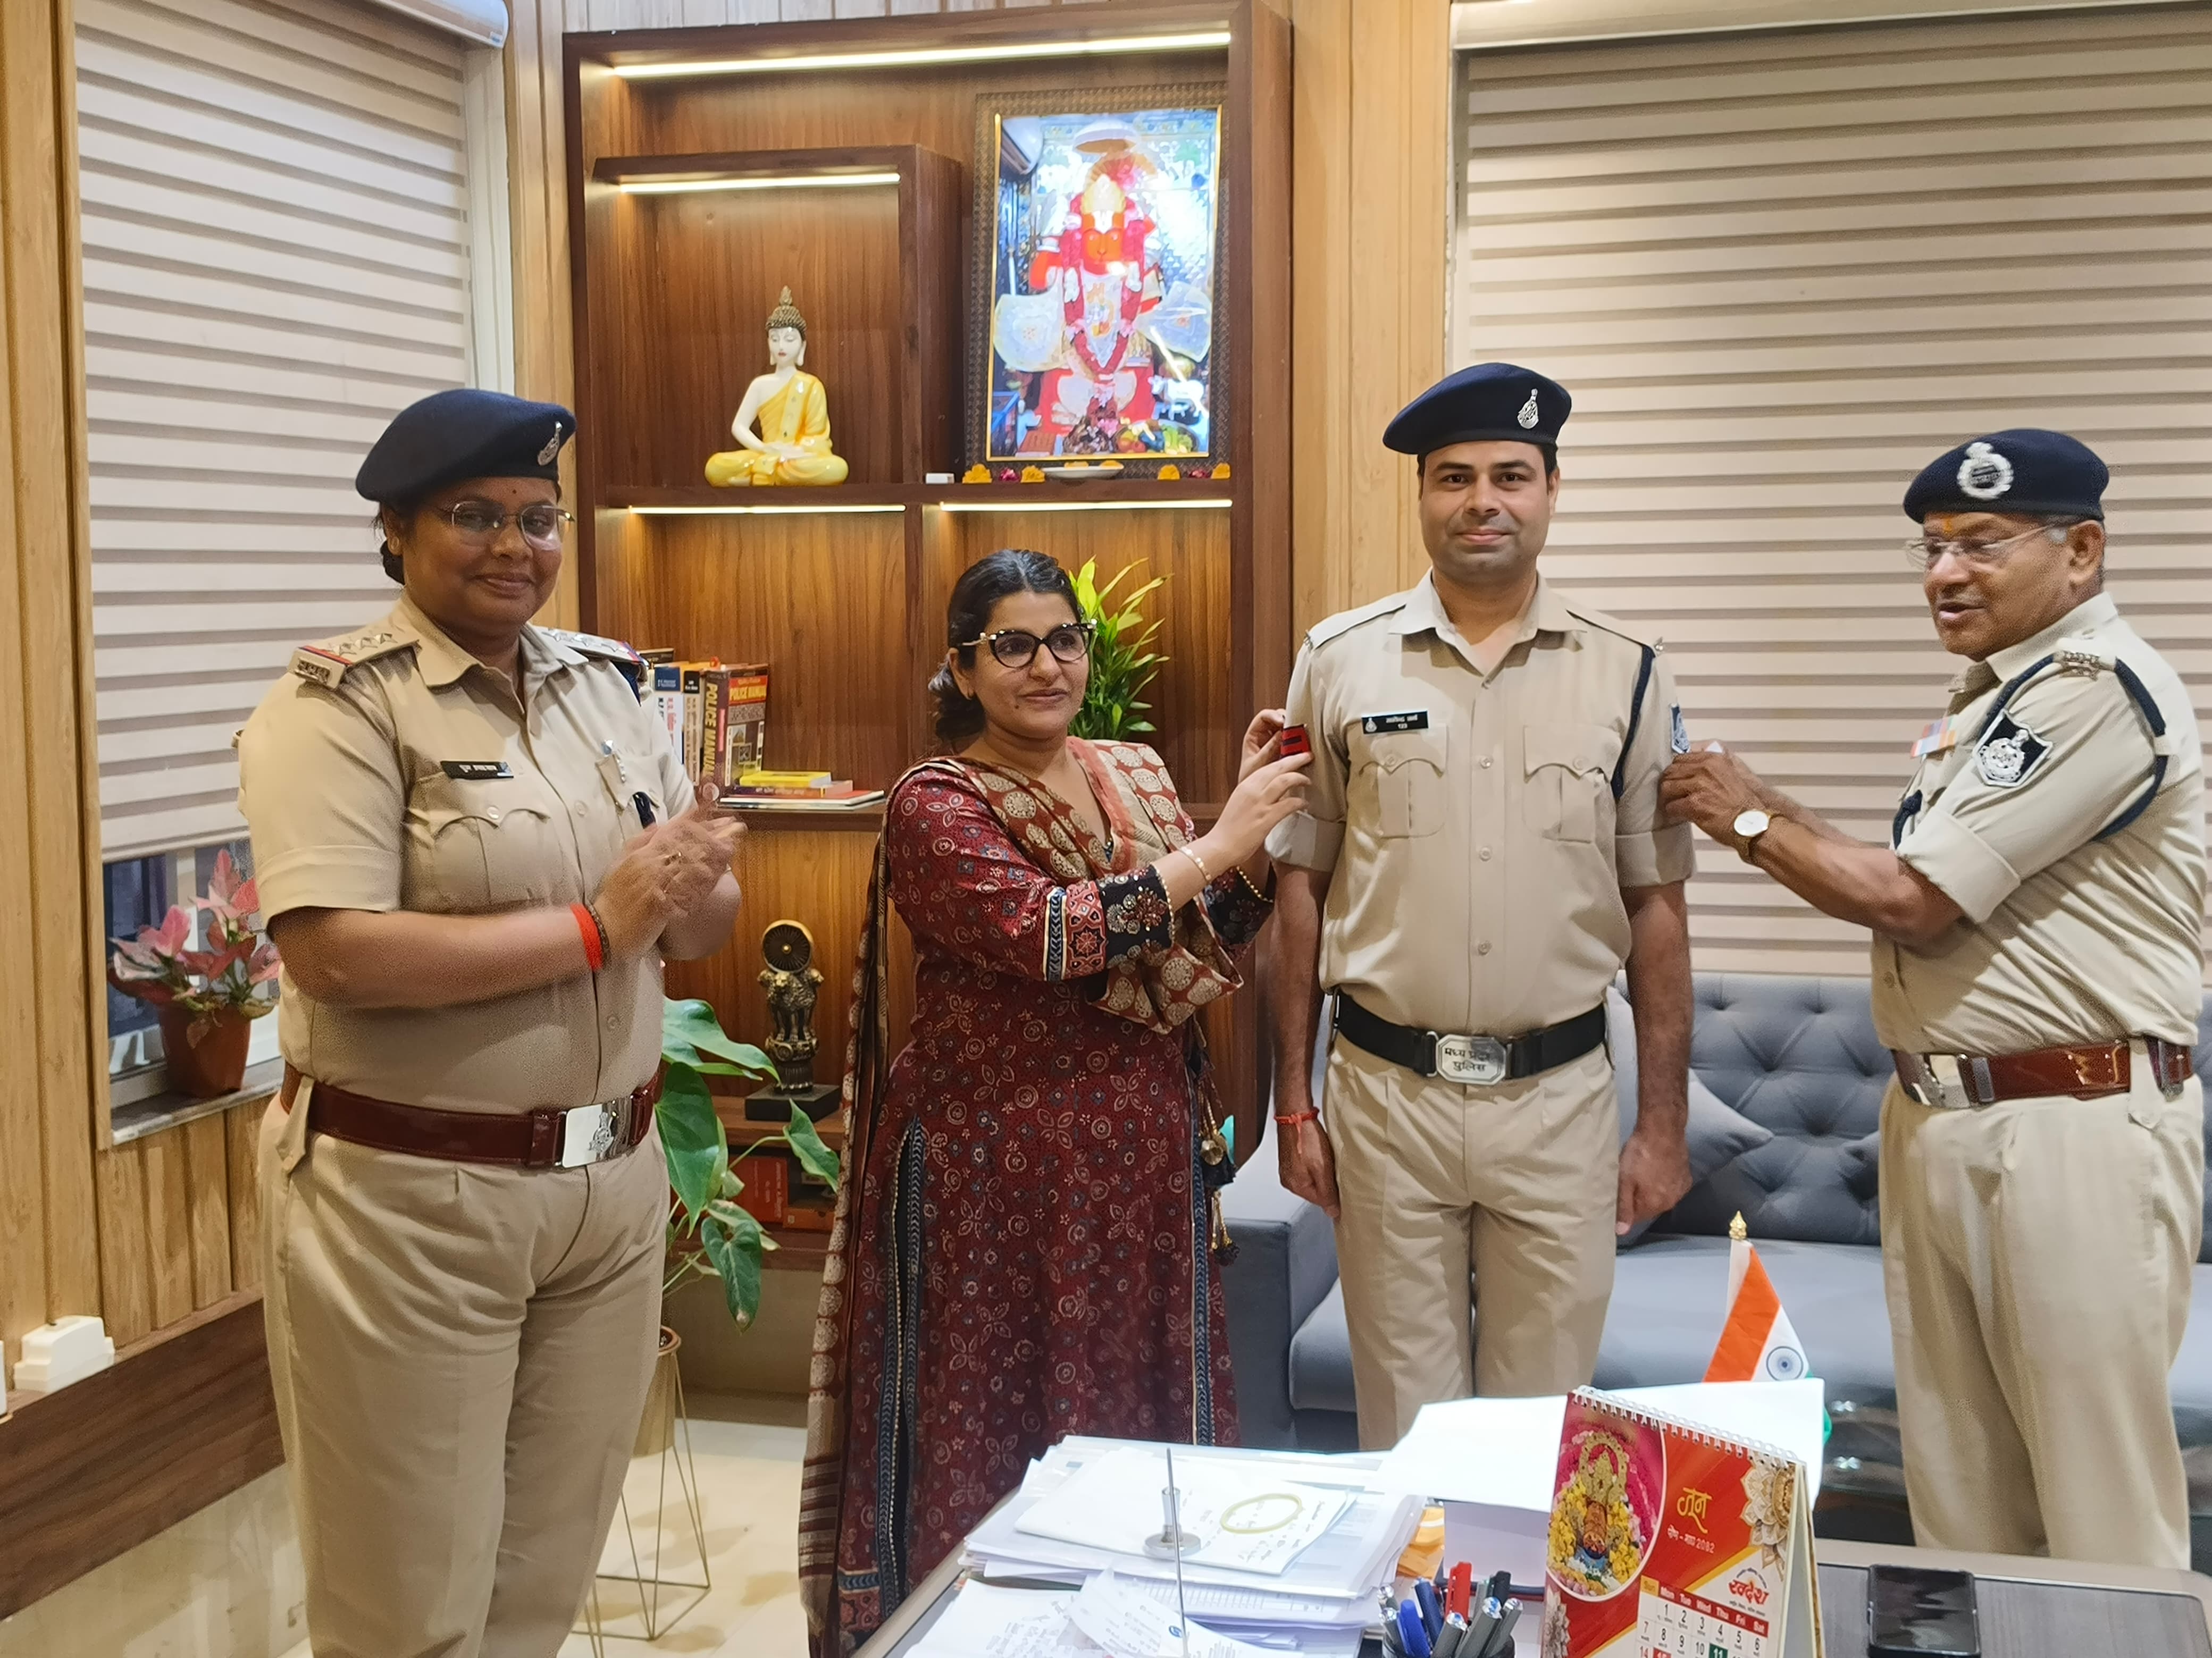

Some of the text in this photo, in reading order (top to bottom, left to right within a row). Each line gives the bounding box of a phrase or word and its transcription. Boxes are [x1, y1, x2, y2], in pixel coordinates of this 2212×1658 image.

[703, 684, 718, 777] POLICE MANUAL
[1452, 1061, 1486, 1072] पुलिस
[1677, 1487, 1713, 1535] जून
[1644, 1580, 1656, 1594] Sun
[1661, 1586, 1675, 1599] Mon
[1680, 1593, 1691, 1605] Tue
[1696, 1600, 1712, 1613] Wed
[1716, 1606, 1729, 1620] Thu
[1736, 1614, 1746, 1626] Fri
[1754, 1621, 1765, 1634] Sat
[1728, 1579, 1769, 1605] स्वदेश
[1644, 1621, 1649, 1633] 7
[1661, 1628, 1666, 1641] 8
[1679, 1635, 1685, 1647] 9
[1696, 1642, 1705, 1655] 10
[1713, 1648, 1723, 1658] 11
[1664, 1604, 1668, 1616] 1
[1681, 1610, 1687, 1622] 2
[1700, 1617, 1705, 1629] 3
[1717, 1624, 1723, 1636] 4
[1736, 1630, 1741, 1643] 5
[1755, 1638, 1760, 1651] 6
